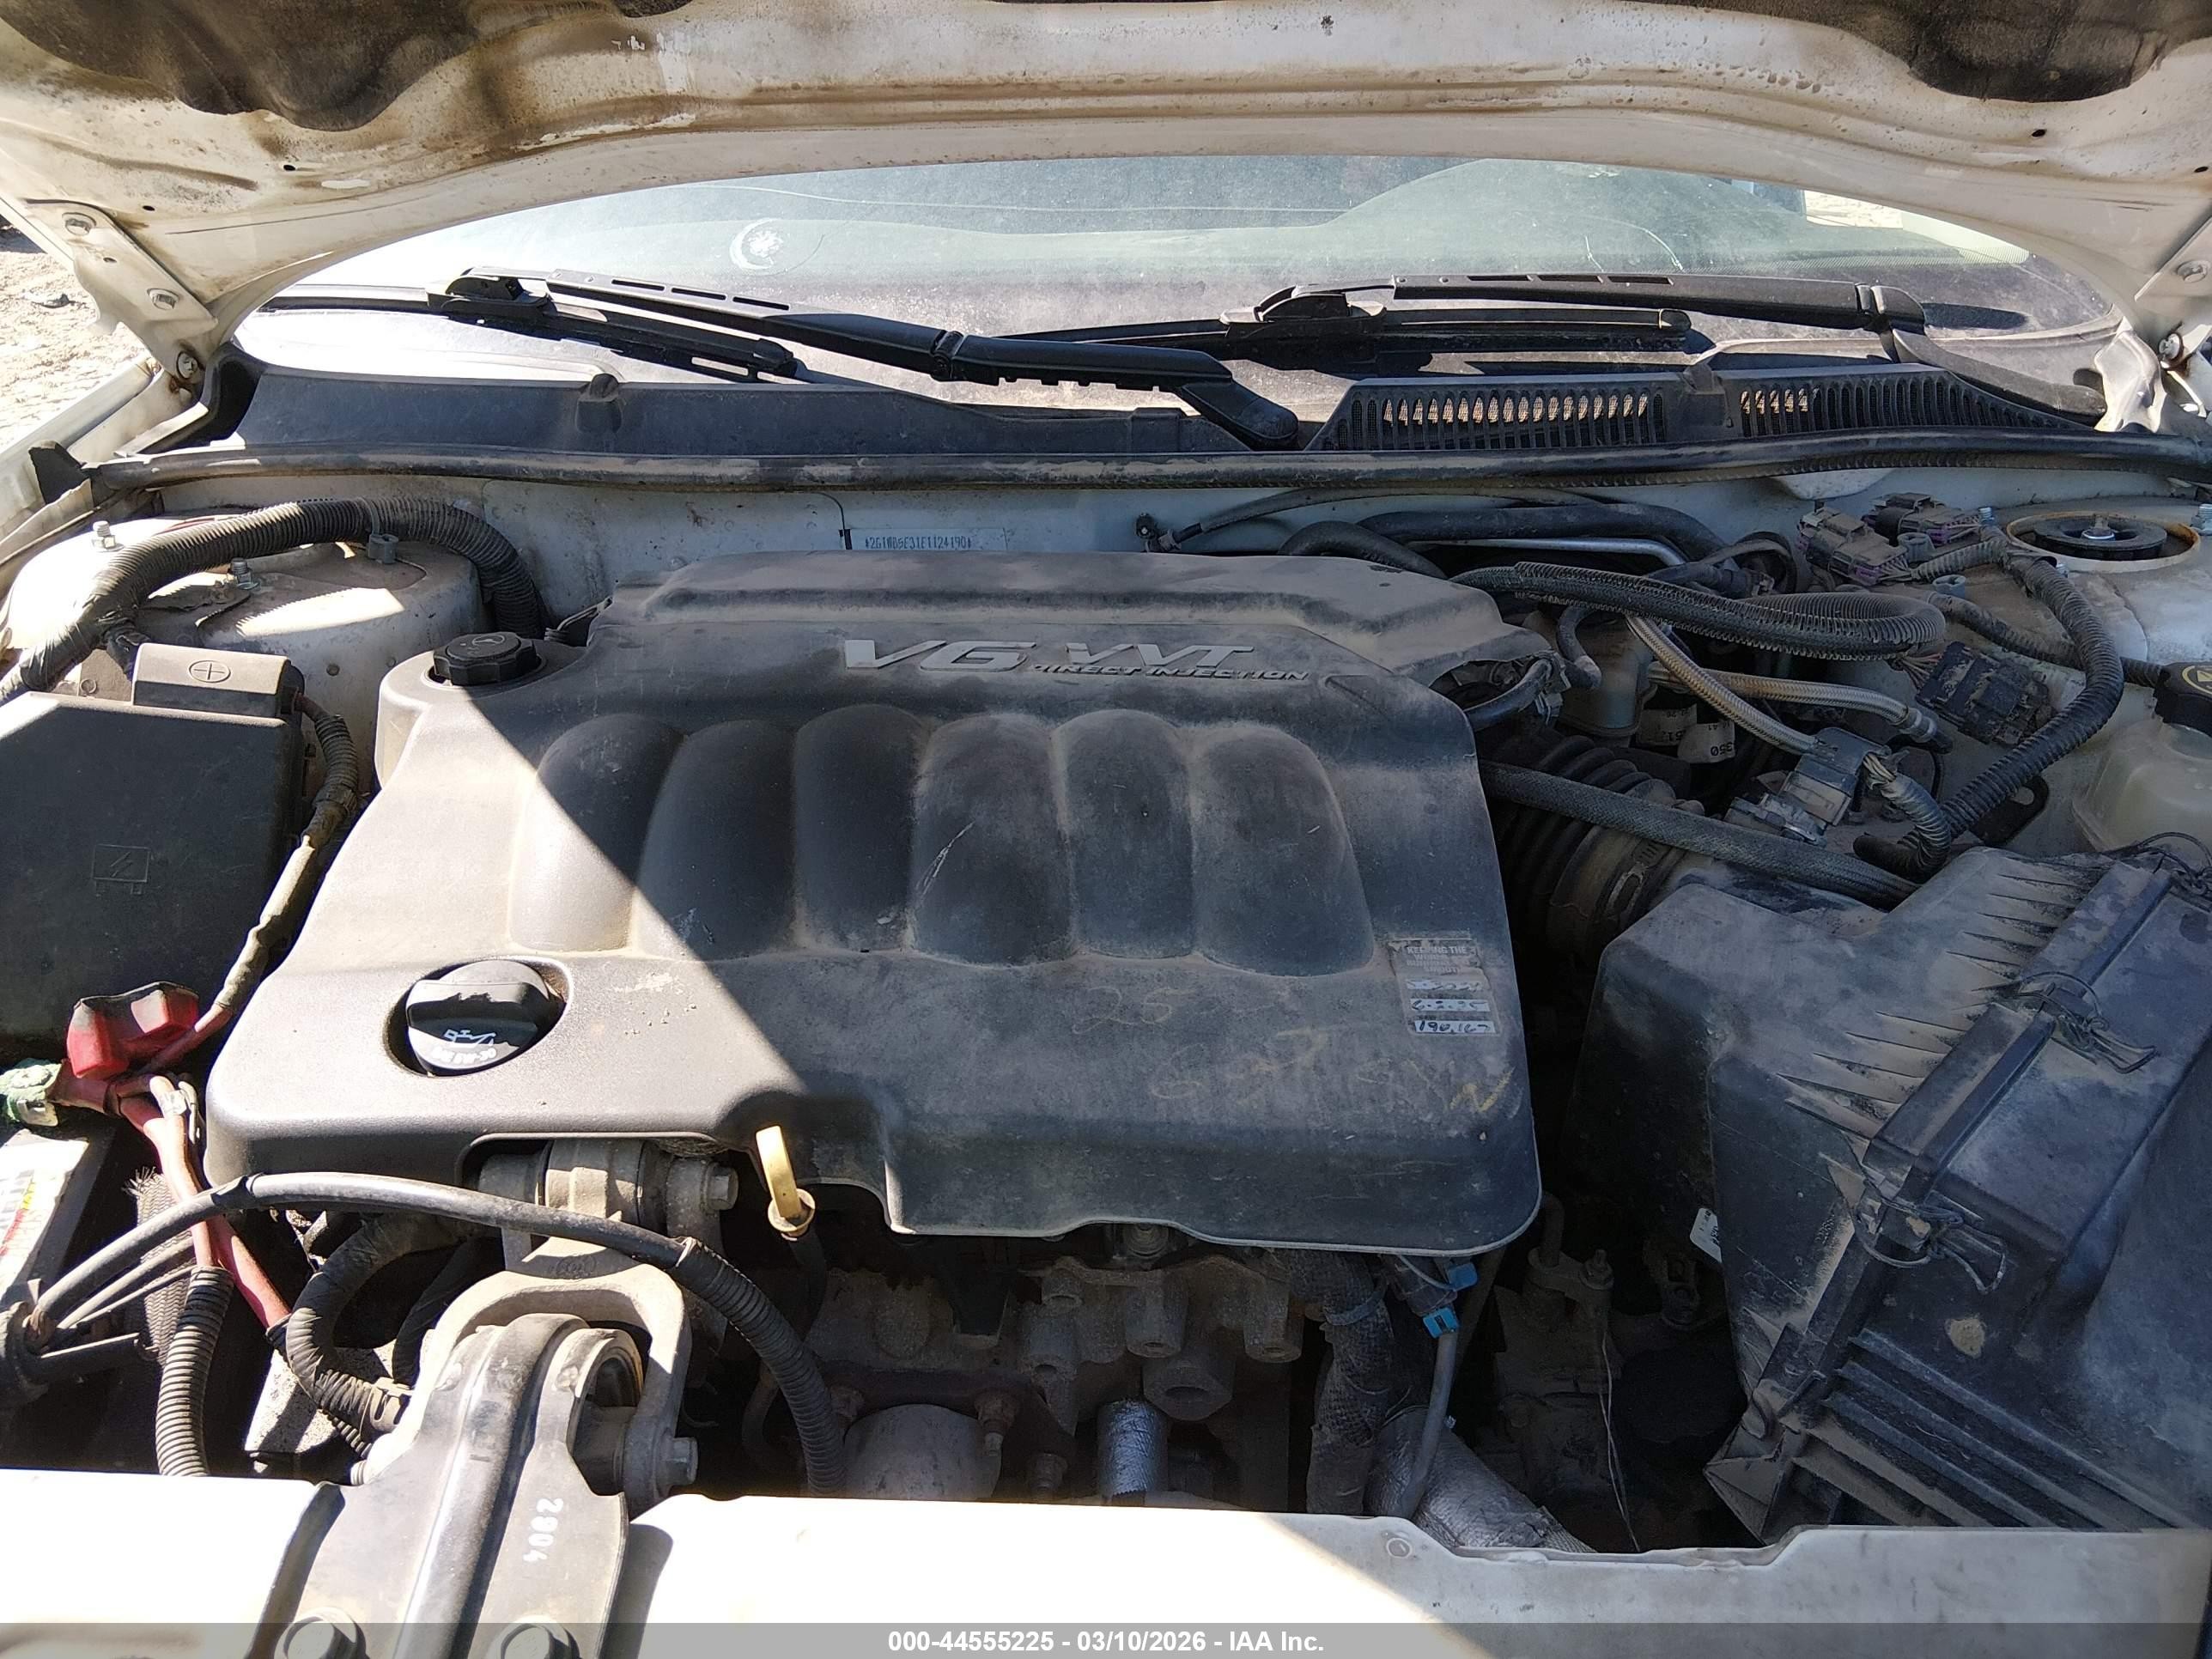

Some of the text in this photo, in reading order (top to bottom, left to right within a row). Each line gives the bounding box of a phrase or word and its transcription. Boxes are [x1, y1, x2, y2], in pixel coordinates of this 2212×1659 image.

[843, 639, 1255, 672] V6 VVT
[1032, 665, 1310, 681] DIRECT INJECTION
